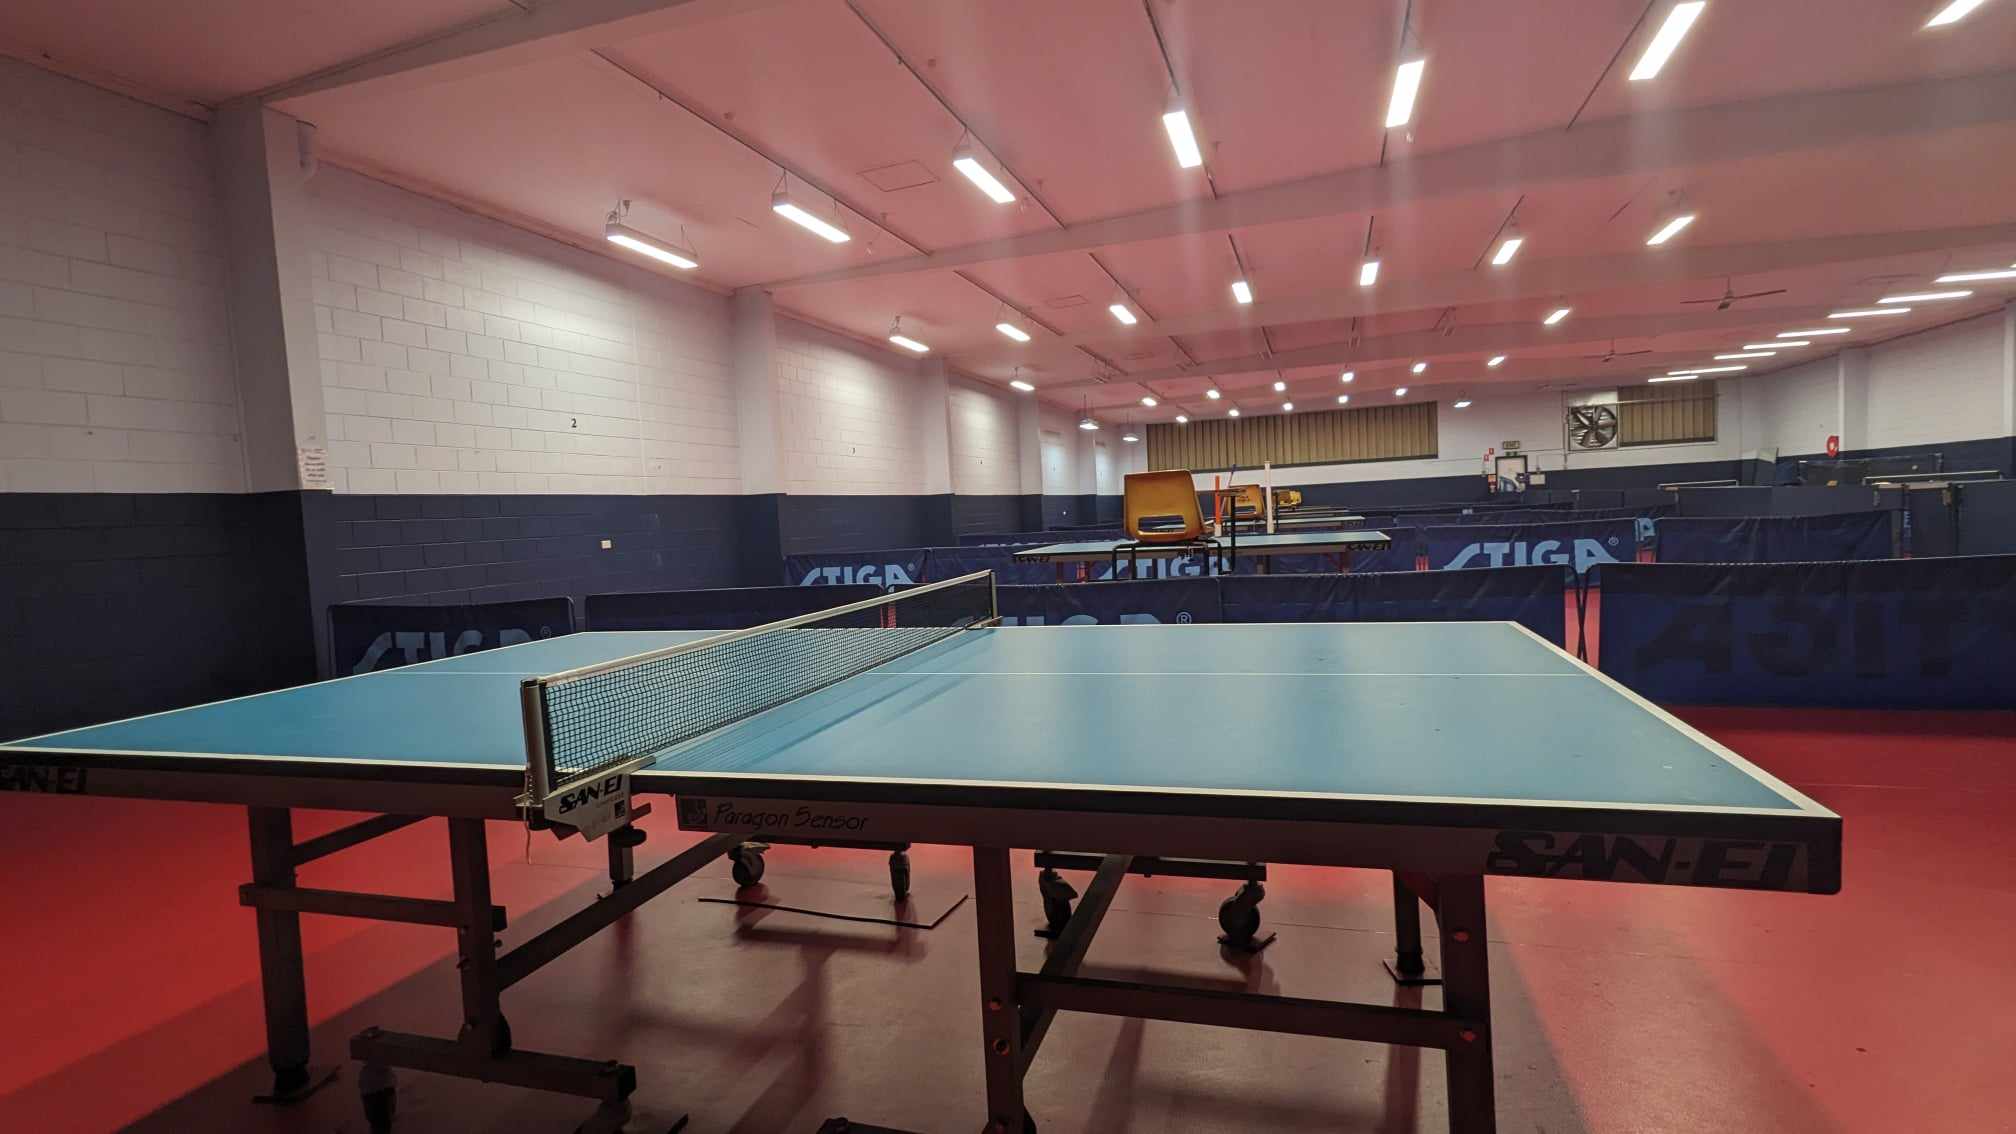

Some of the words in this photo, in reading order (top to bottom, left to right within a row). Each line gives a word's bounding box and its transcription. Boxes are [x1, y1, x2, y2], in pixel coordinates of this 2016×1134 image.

[571, 418, 577, 428] 2
[1443, 539, 1619, 573] STIGA
[800, 565, 914, 590] STIGA
[0, 767, 87, 795] AN-EI
[559, 774, 622, 814] SAN-EI
[713, 801, 789, 830] Paragon
[795, 806, 870, 831] Sensor
[1486, 830, 1797, 888] SAN-EI
